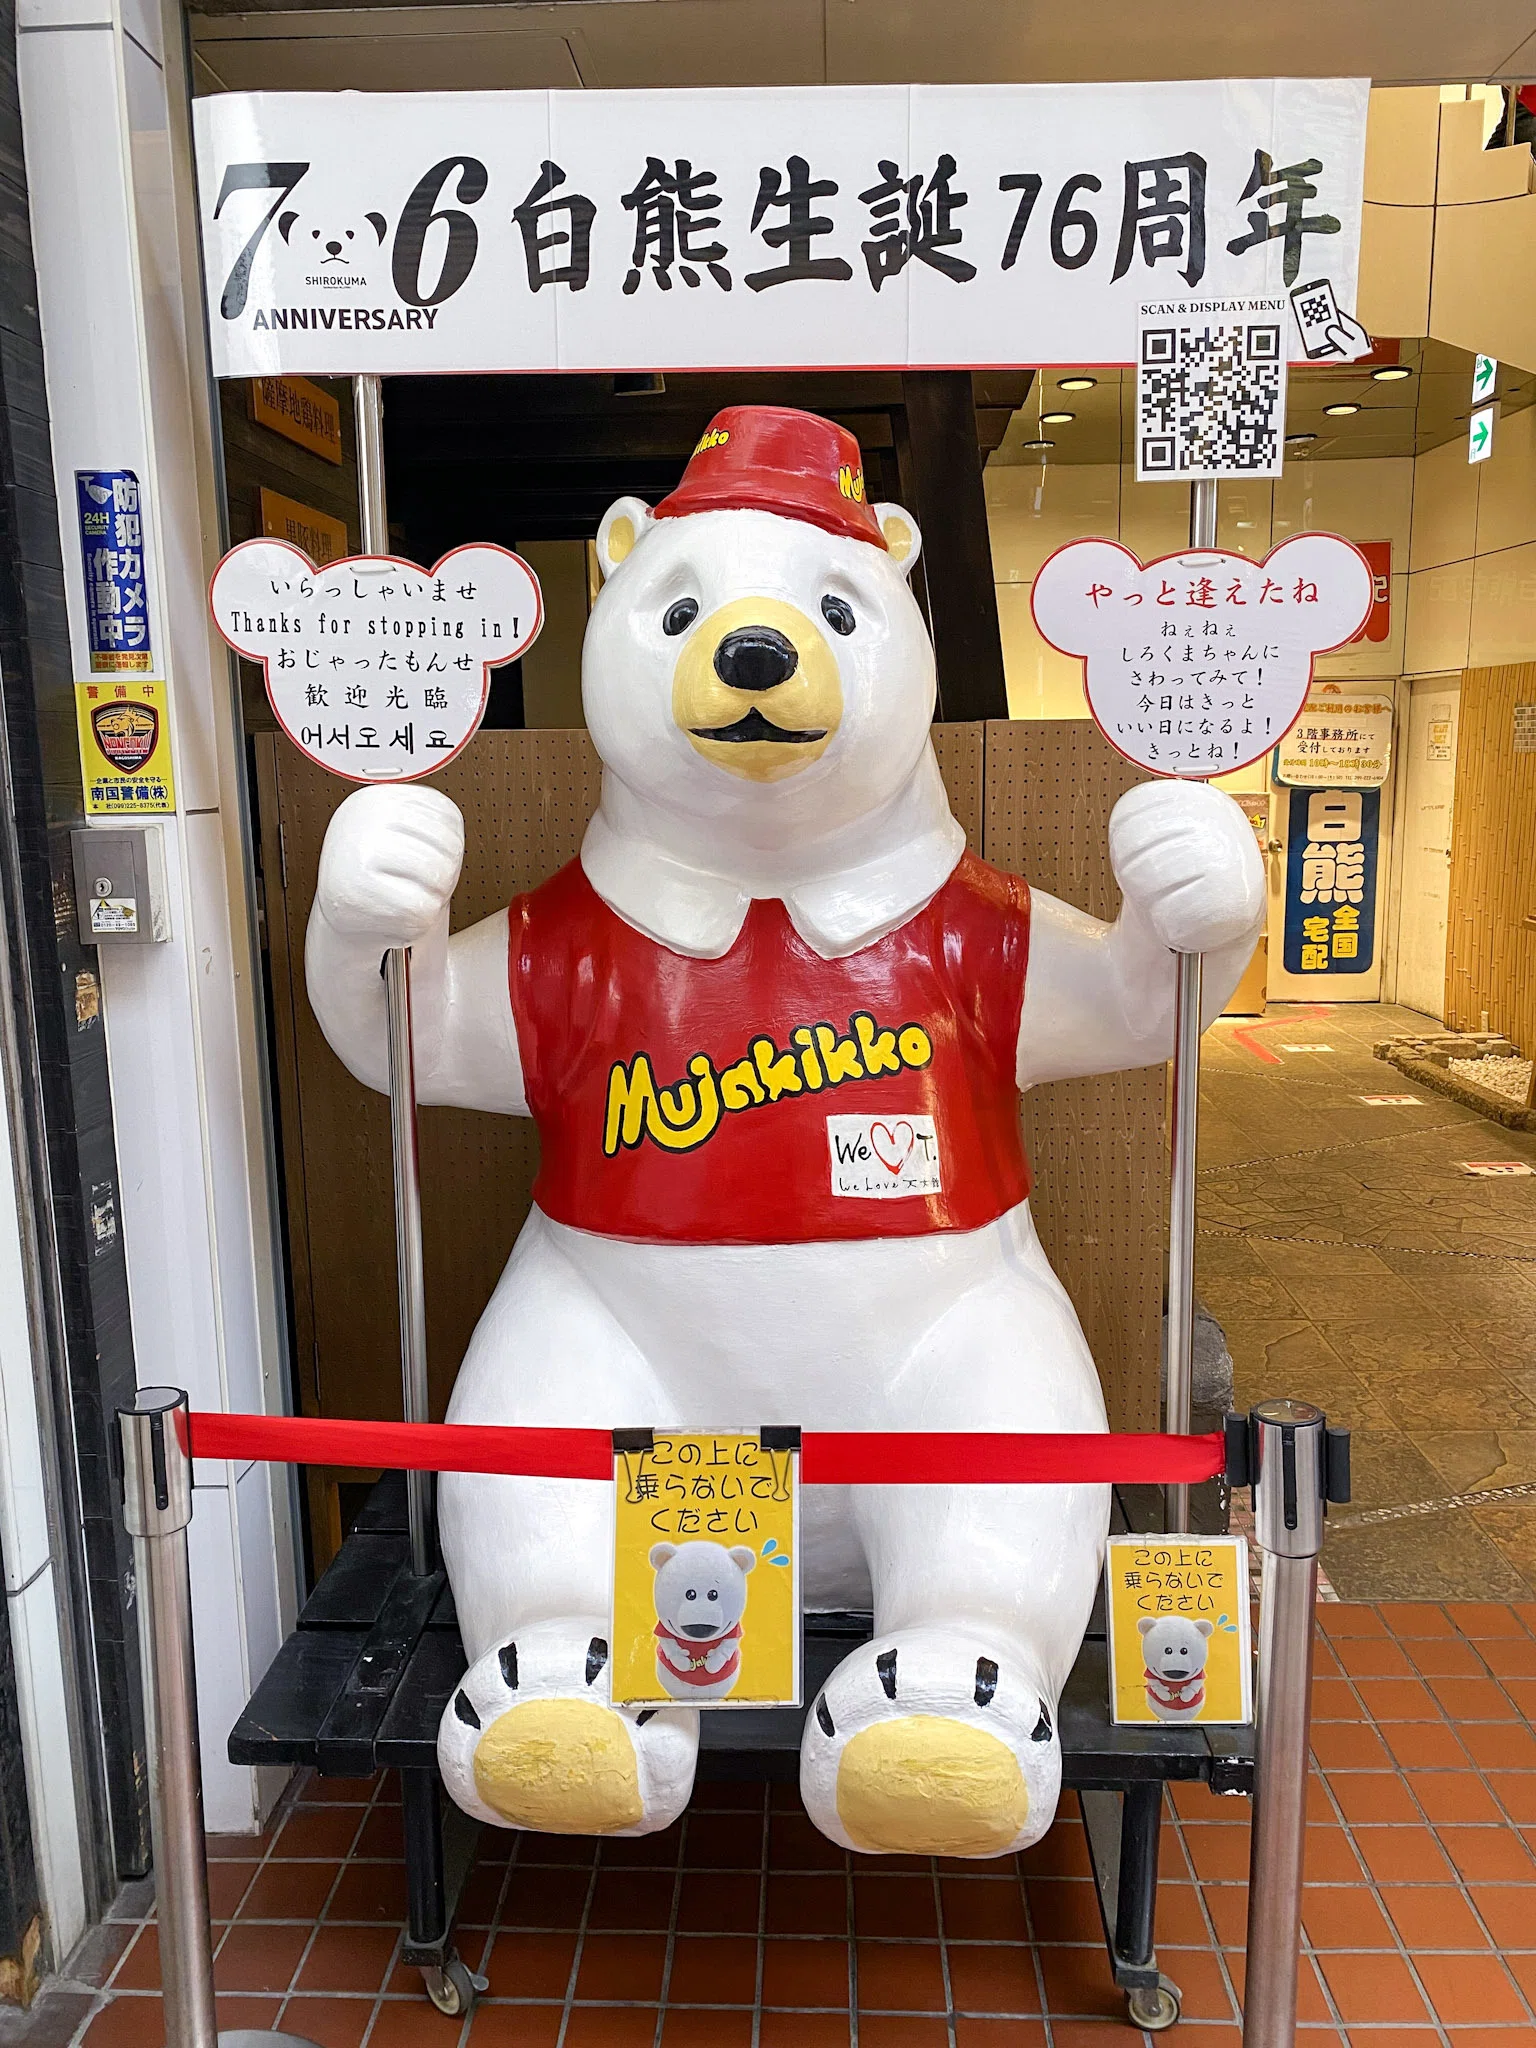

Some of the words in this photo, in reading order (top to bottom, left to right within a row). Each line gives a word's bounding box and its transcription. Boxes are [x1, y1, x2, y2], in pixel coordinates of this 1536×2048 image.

[305, 276, 367, 286] SHIROKUMA
[1141, 304, 1174, 315] SCAN
[1177, 303, 1187, 313] &
[1190, 301, 1245, 313] DISPLAY
[1248, 300, 1286, 311] MENU
[252, 308, 438, 331] ANNIVERSARY
[84, 512, 110, 524] 24H
[112, 478, 146, 647] 防犯カメラ
[94, 548, 124, 648] 作動中
[270, 578, 478, 602] いらっしゃいませ
[1085, 577, 1319, 609] やっと逢えたね
[231, 611, 301, 633] Thanks
[318, 613, 351, 634] for
[368, 615, 464, 639] stopping
[1161, 620, 1236, 638] ねぇねぇ
[277, 649, 474, 673] おじゃったもんせ
[1122, 645, 1279, 662] しろくまちゃんに
[1130, 668, 1263, 687] さわってみて！
[86, 685, 154, 698] 警備中
[304, 683, 449, 710] 歓迎光臨
[1136, 694, 1254, 712] 今日はきっと
[1117, 717, 1272, 736] いい日になるよ！
[1297, 728, 1375, 740] 3階事務所にて
[300, 722, 455, 755] 어서오세요
[1297, 740, 1371, 754] 受付しております
[1148, 742, 1240, 760] きっとね！
[90, 785, 168, 801] 南国警備(株)
[1331, 904, 1360, 959] 全国
[1301, 916, 1329, 970] 宅配
[602, 1010, 934, 1158] Mujakikko
[835, 1133, 872, 1164] We
[651, 1440, 758, 1466] この上に
[635, 1473, 773, 1500] 乗らないで
[650, 1508, 758, 1533] ください
[1134, 1549, 1213, 1567] この上に
[1124, 1571, 1224, 1589] 乗らないで
[1136, 1594, 1214, 1611] ください
